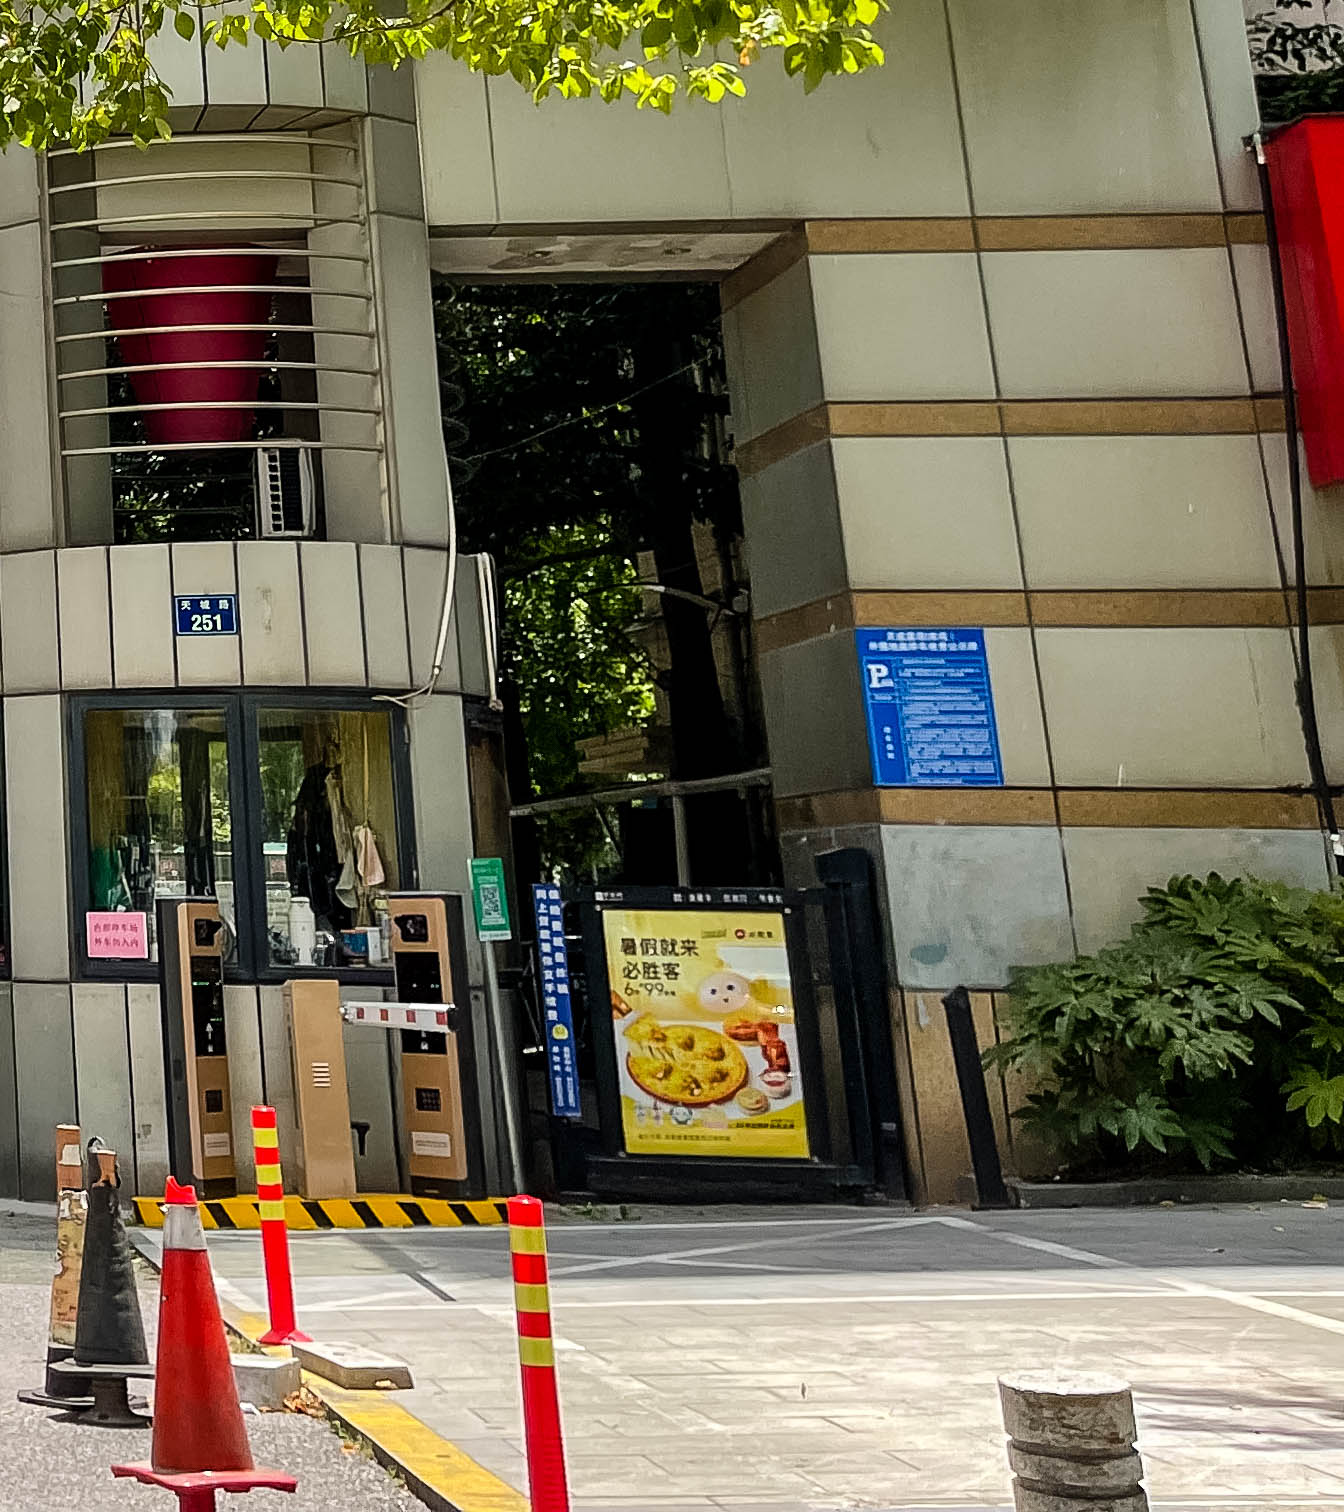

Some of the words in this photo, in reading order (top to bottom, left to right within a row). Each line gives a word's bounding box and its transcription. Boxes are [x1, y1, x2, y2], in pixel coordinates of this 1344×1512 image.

[191, 614, 222, 631] 251
[620, 938, 700, 957] 暑假就来
[623, 961, 681, 981] 必胜客
